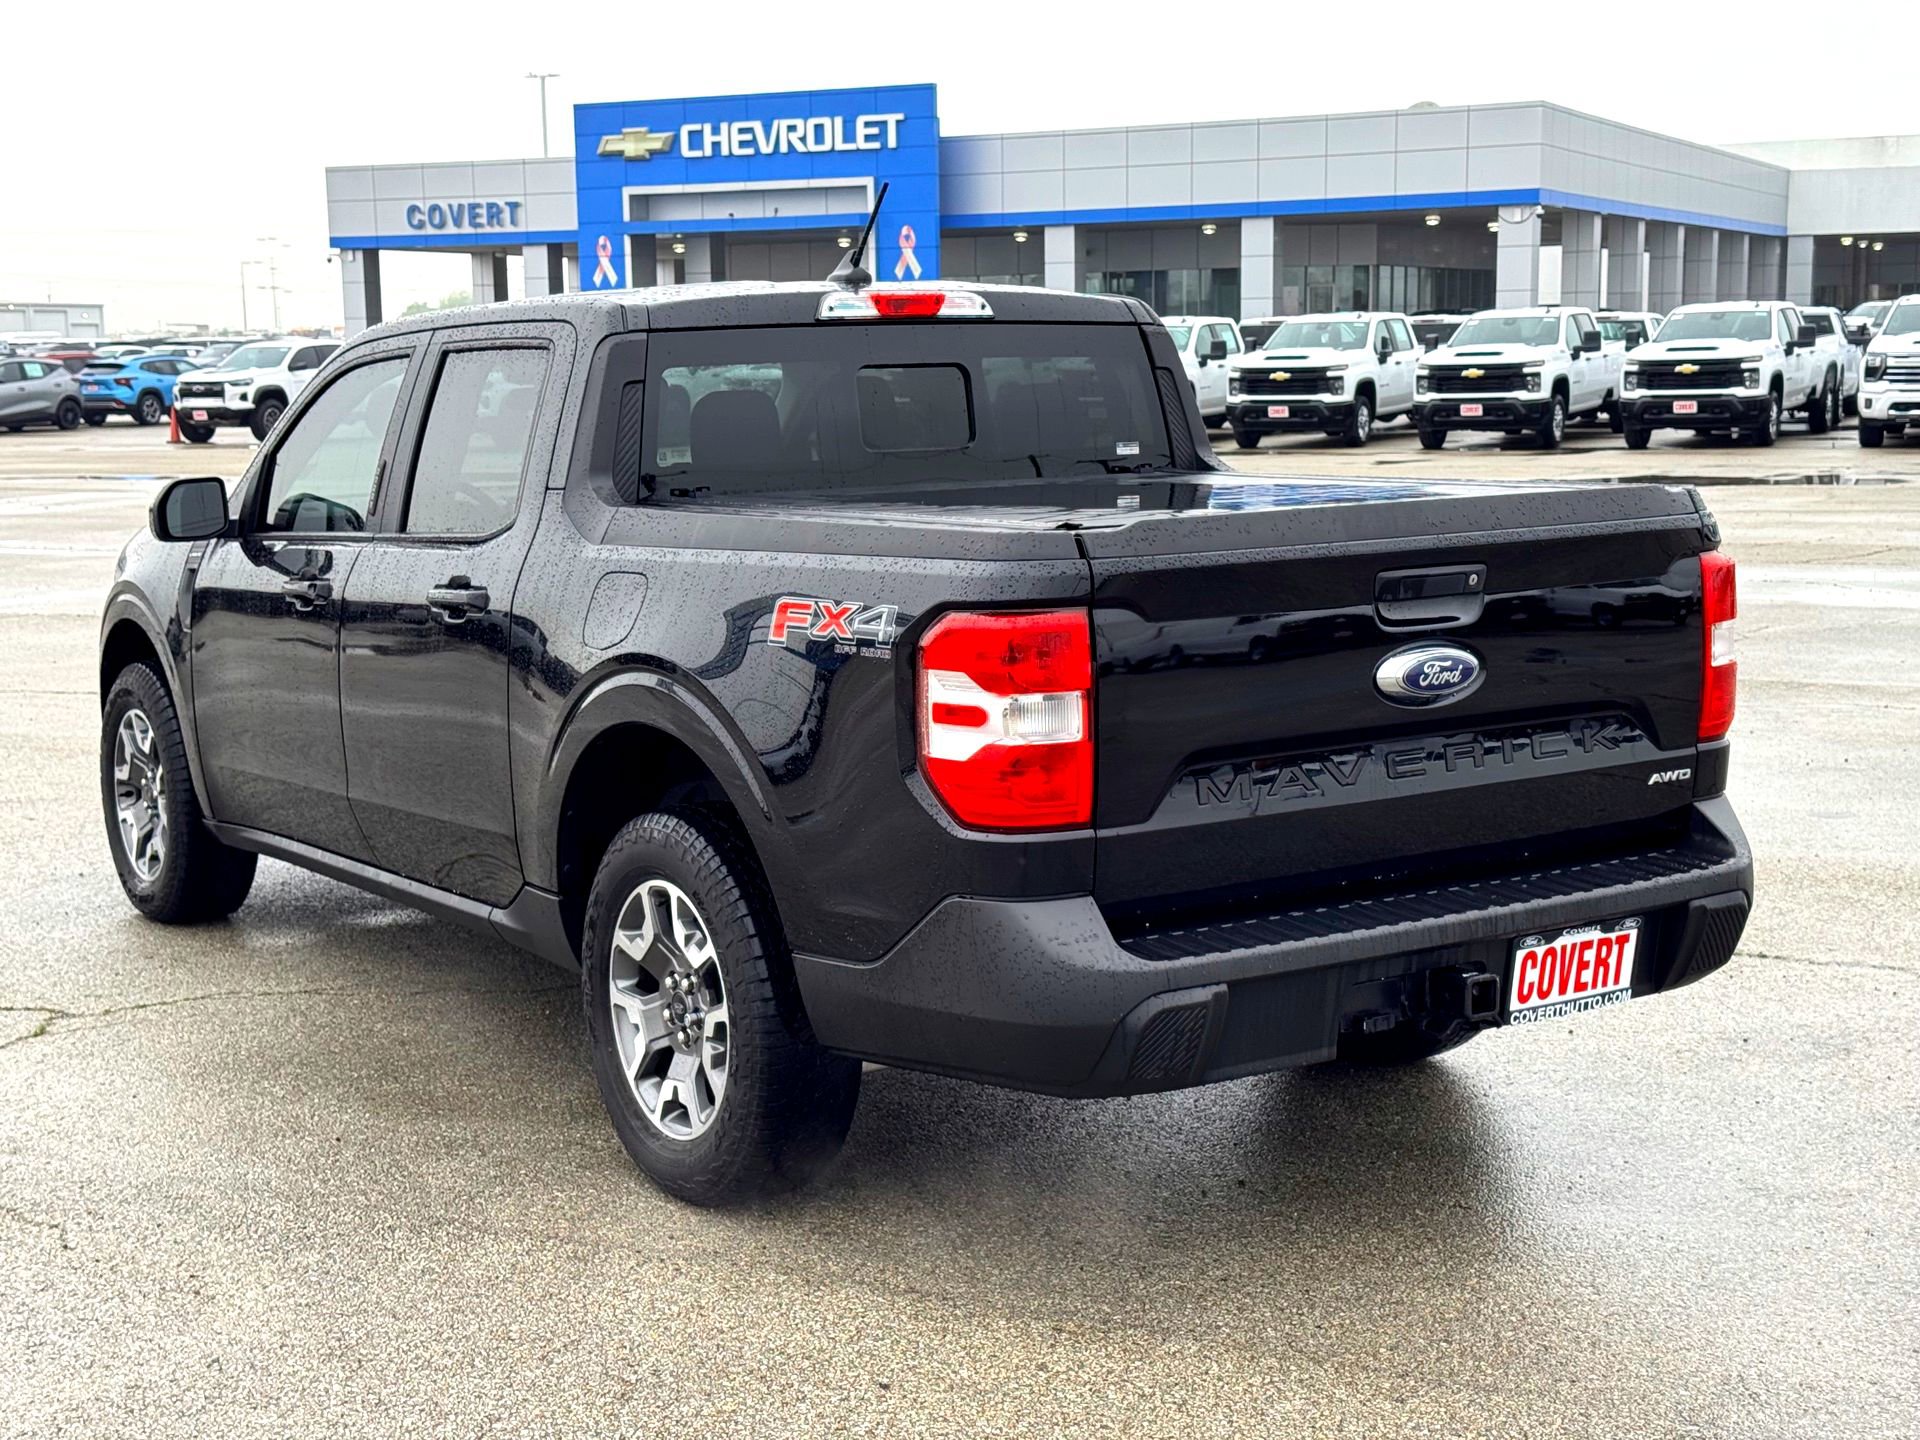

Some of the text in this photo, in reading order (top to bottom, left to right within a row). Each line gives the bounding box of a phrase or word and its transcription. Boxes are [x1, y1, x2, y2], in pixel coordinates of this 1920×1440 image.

[680, 113, 905, 158] CHEVROLET
[406, 201, 523, 230] COVERT
[767, 596, 898, 648] FX4
[1419, 660, 1463, 686] Ford
[1195, 723, 1623, 806] MAVERICK
[1647, 768, 1692, 786] AWD
[1517, 933, 1631, 1005] COVERT
[1510, 989, 1632, 1025] COVERTHUTTO.COM
